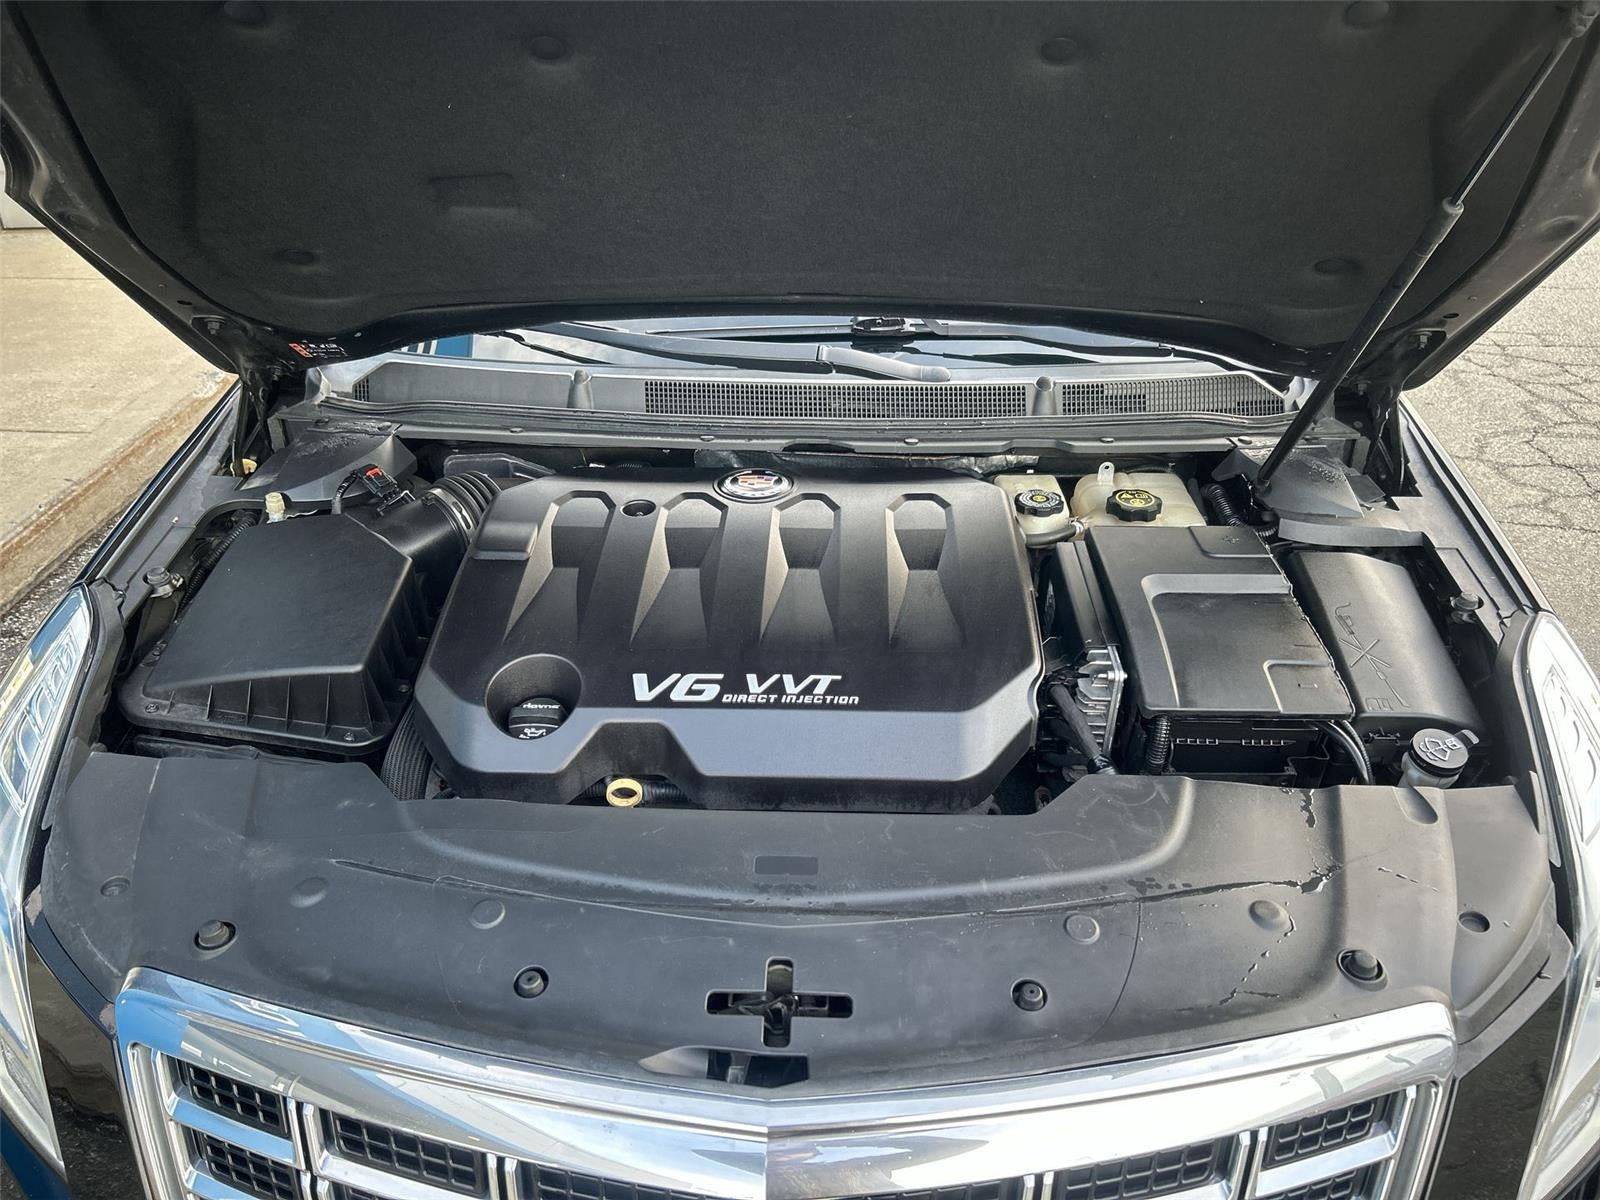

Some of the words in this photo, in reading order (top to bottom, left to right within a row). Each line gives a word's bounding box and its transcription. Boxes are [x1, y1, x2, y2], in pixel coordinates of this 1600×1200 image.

[632, 673, 724, 702] V6
[745, 673, 842, 695] VVT
[721, 693, 778, 704] DIRECT
[781, 694, 860, 705] INJECTION
